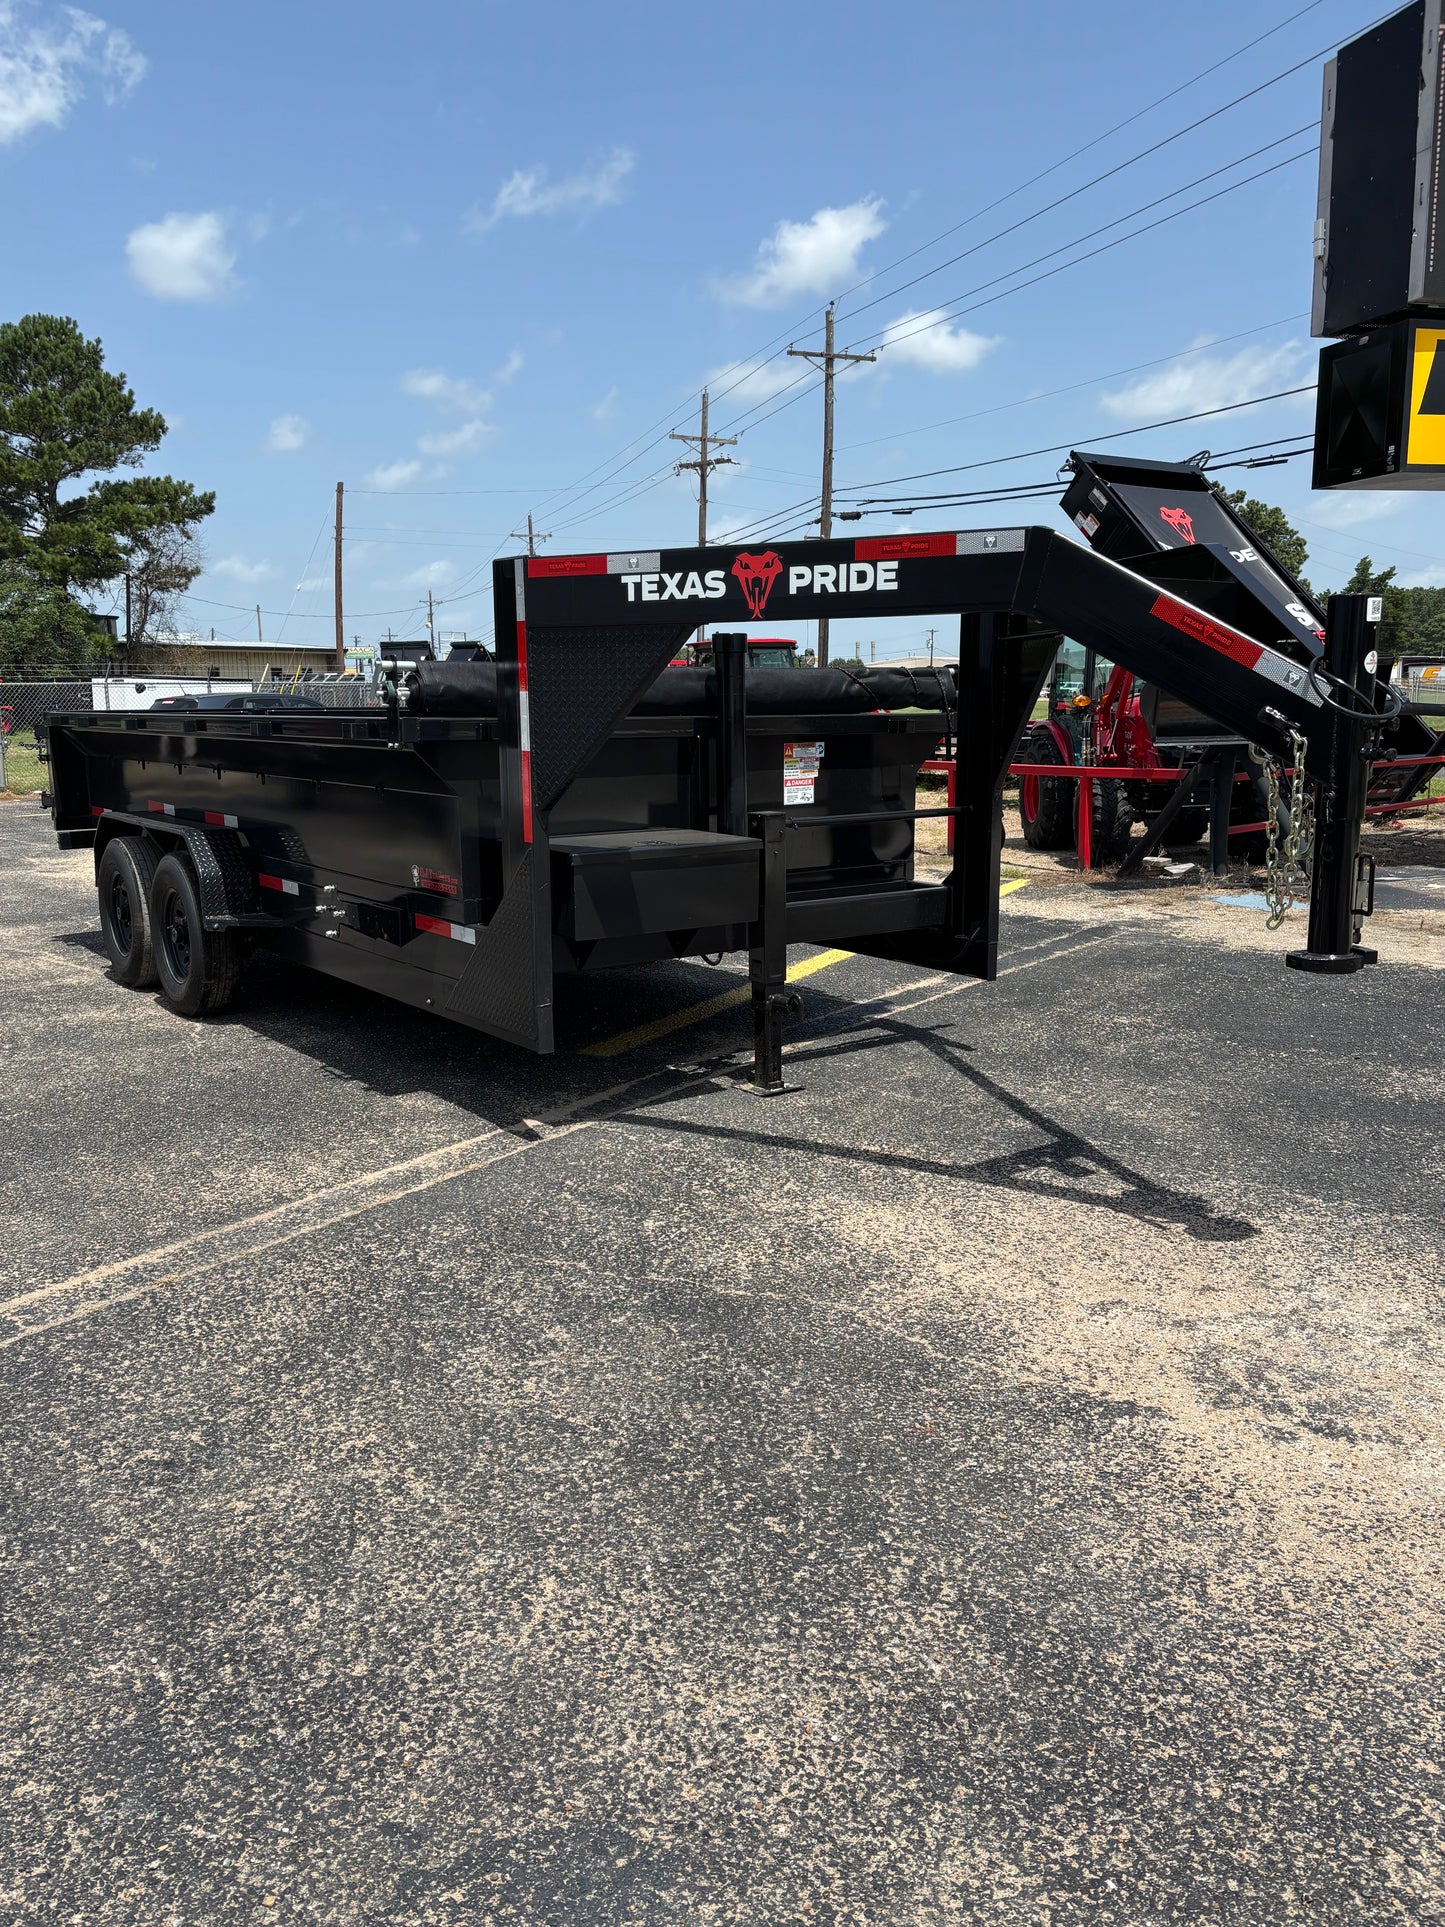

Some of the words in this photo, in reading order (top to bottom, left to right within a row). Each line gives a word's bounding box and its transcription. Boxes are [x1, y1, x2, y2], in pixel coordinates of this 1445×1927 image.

[621, 570, 727, 602] TEXAS
[788, 560, 899, 595] PRIDE
[1212, 633, 1231, 645] PRIDE
